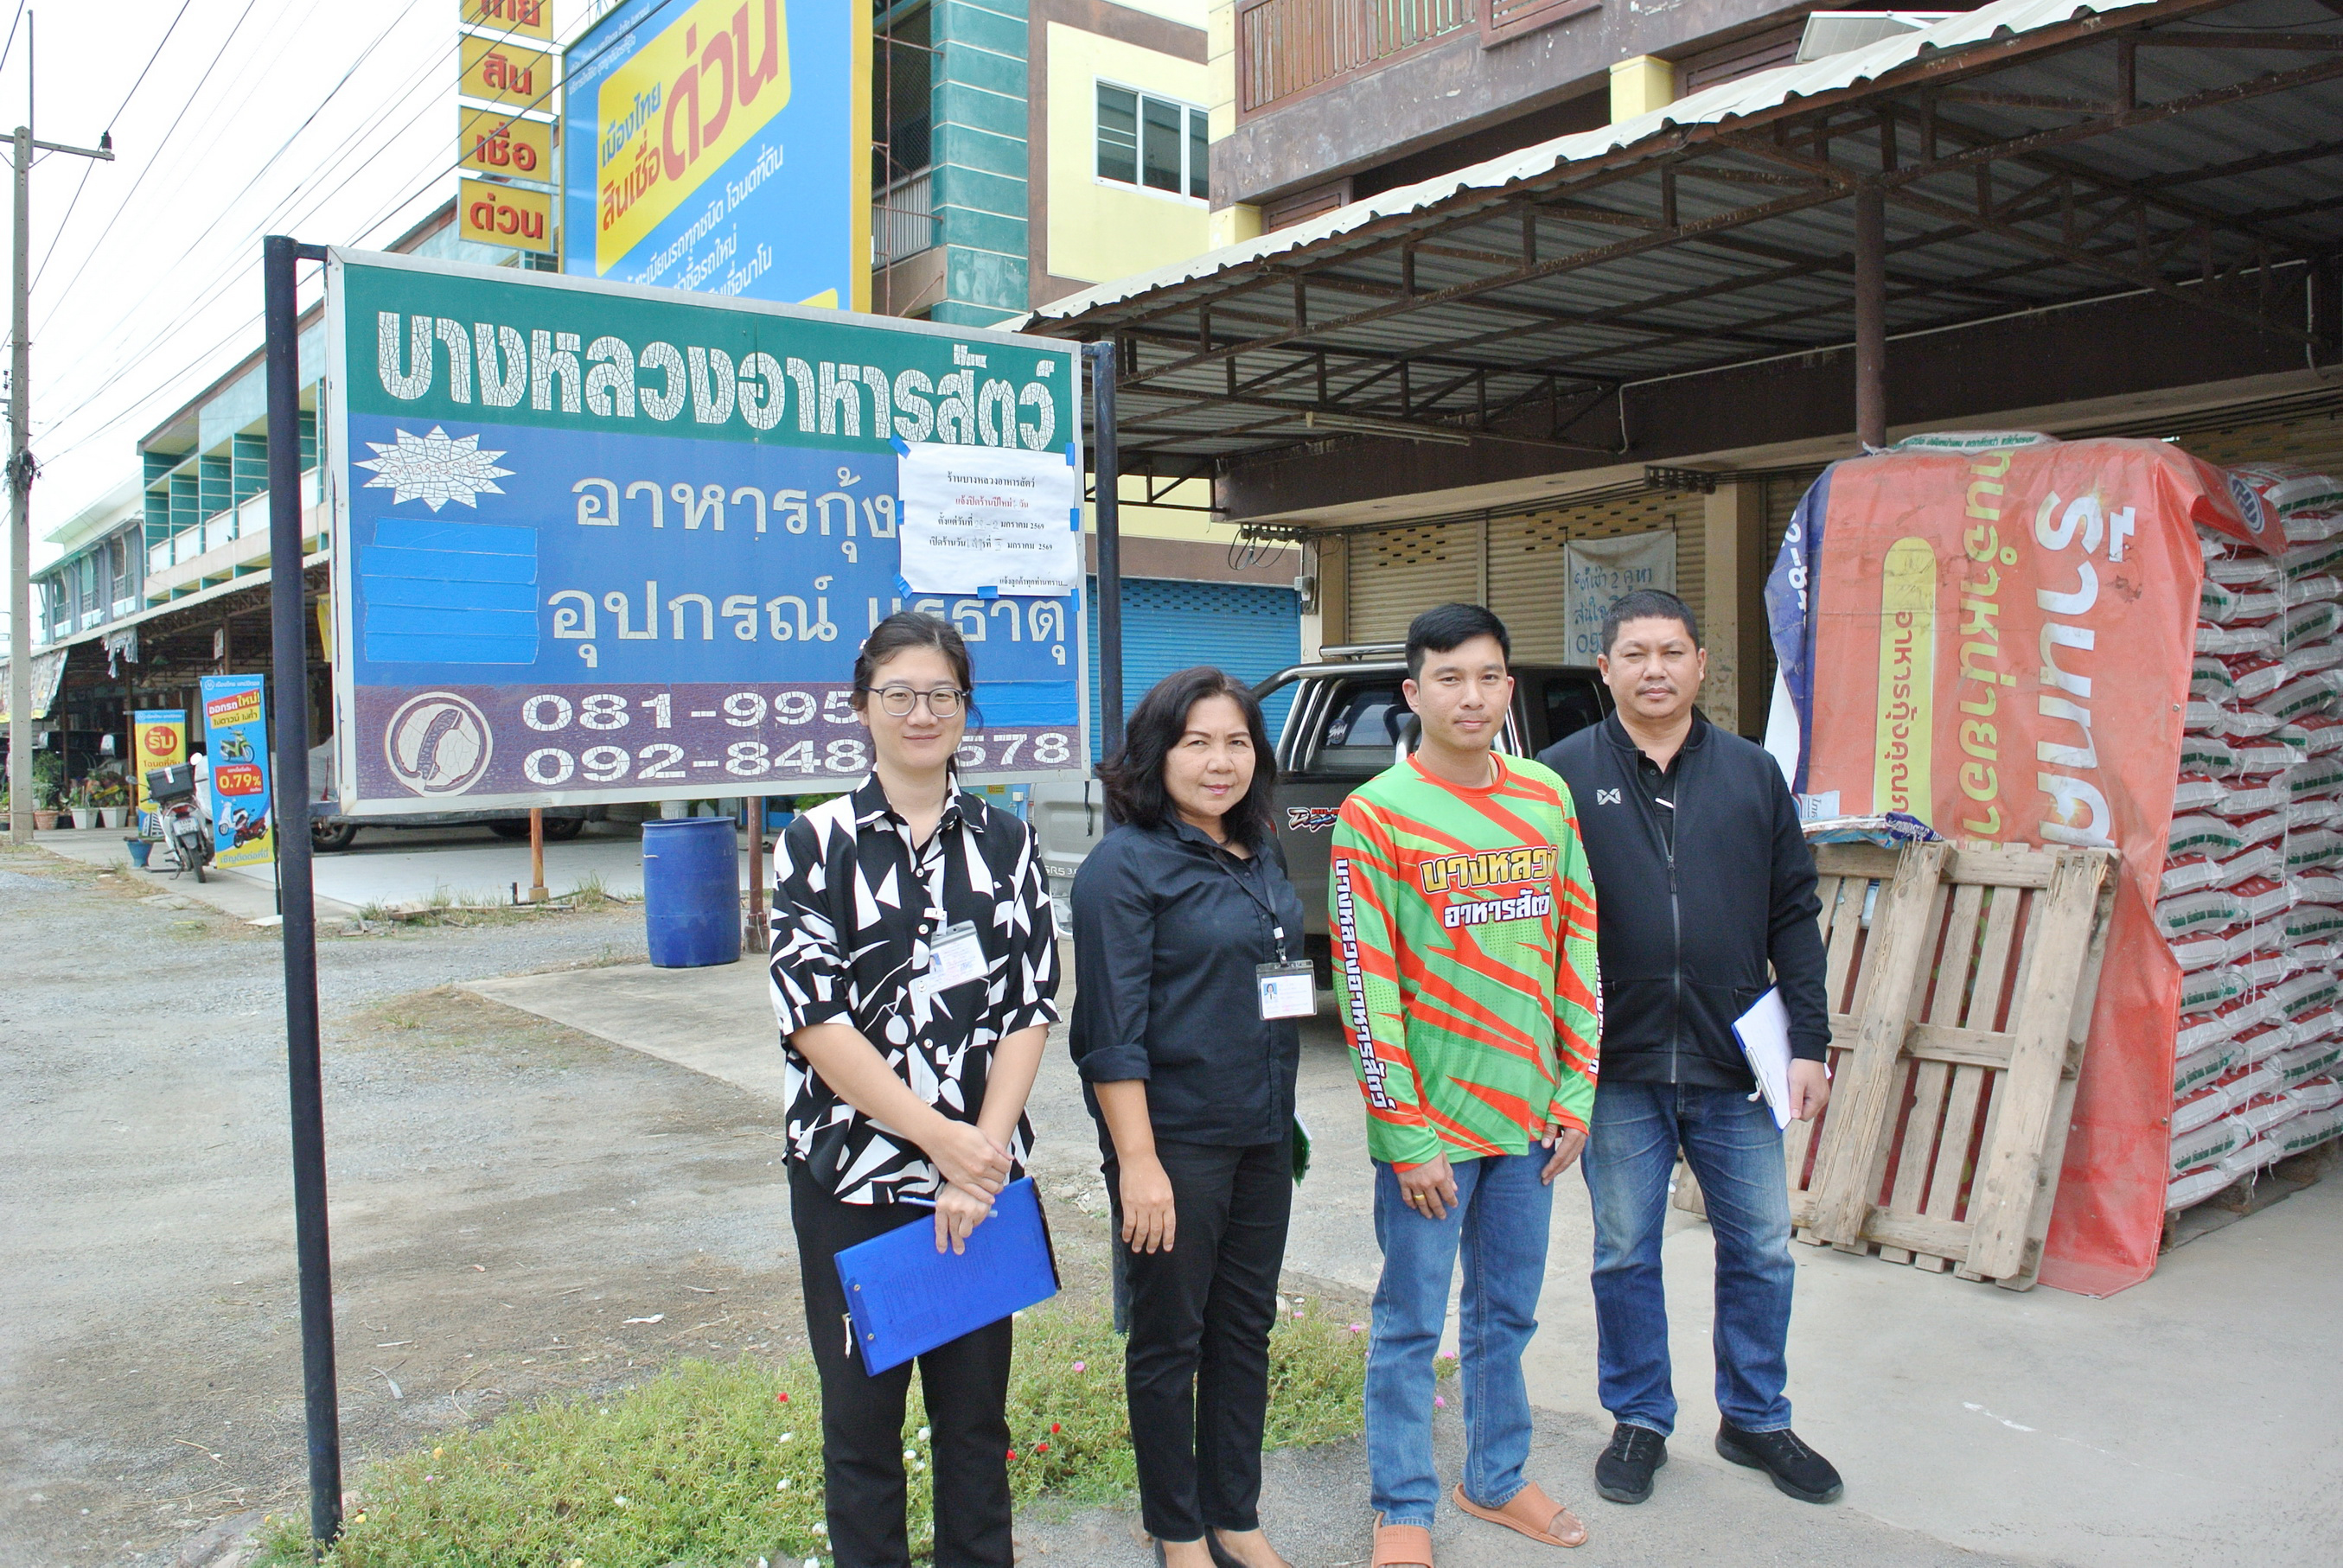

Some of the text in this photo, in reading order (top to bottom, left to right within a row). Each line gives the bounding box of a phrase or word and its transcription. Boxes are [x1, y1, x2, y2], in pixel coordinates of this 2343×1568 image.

[481, 0, 540, 28] ทย
[483, 51, 533, 96] สิน
[663, 0, 779, 182] ด่วน
[476, 122, 537, 172] เชื่อ
[601, 81, 662, 169] เมืองไทย
[602, 130, 661, 233] สินเชื่อ
[726, 143, 784, 214] โฉนดที่ดิน
[470, 193, 544, 240] ด่วน
[378, 311, 1057, 452] บางหลวงอาหารสัตว์
[947, 471, 1036, 488] ร้านบางหลวงอาหารสัตว์
[571, 466, 897, 563] อาหารกุ้ง
[1000, 520, 1028, 529] มกราคม
[1007, 541, 1035, 550] มกราคม
[1574, 565, 1653, 592] ให้เช่า 2 คูหา
[547, 576, 838, 669] อุปกรณ์
[1576, 632, 1603, 653] 09
[1958, 449, 2019, 851] ทนจำหน่ายอา
[522, 691, 859, 732] 081-995
[1884, 610, 1918, 813] อาหารกุ้งคุณภ
[148, 730, 175, 749] รับ
[219, 774, 261, 789] 0.79%
[1444, 885, 1551, 929] อาหารสัตว์
